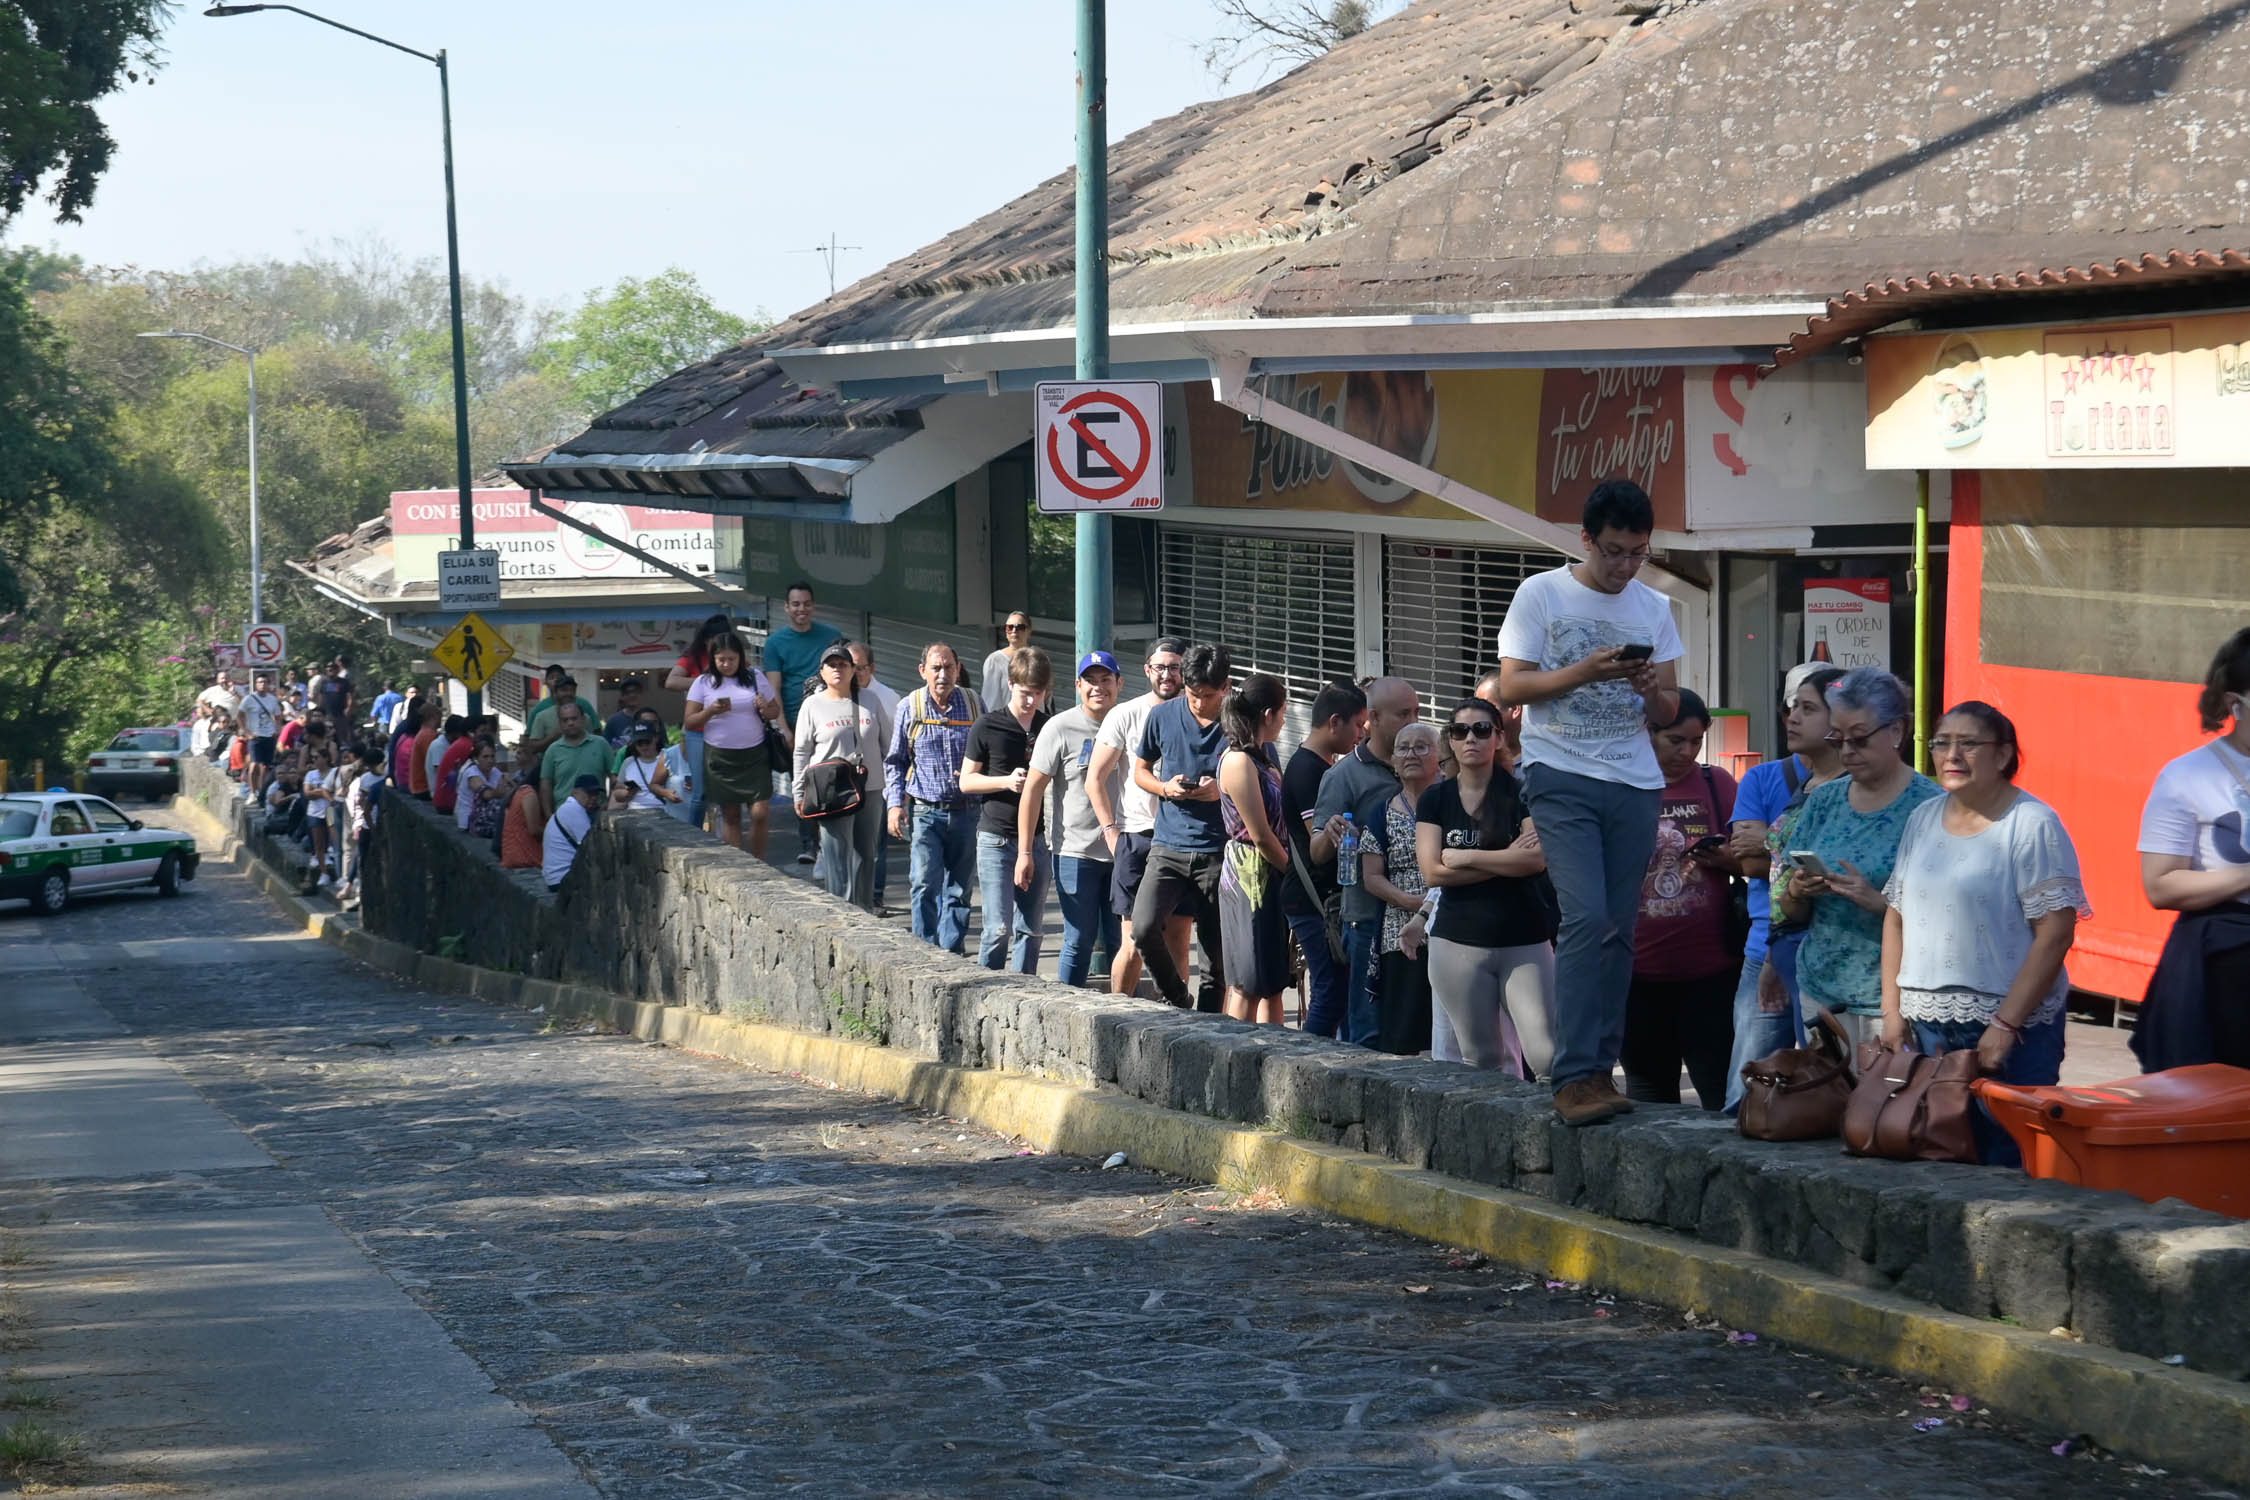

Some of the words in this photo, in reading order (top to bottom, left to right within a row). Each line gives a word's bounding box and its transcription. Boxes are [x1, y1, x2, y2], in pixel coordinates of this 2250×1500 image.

[1130, 497, 1160, 507] ADO
[407, 504, 447, 520] CON
[452, 502, 545, 519] EQUISIT
[448, 537, 555, 557] Dsayunos
[636, 532, 724, 551] Comidas
[443, 558, 475, 569] ELIJA
[480, 557, 494, 567] SU
[499, 561, 556, 576] Tortas
[637, 558, 690, 574] Taos
[447, 575, 492, 586] CARRIL
[1836, 601, 1864, 609] COMBO
[1836, 616, 1882, 634] ORDEN
[1853, 636, 1872, 648] DE
[1840, 652, 1881, 668] TACOS
[826, 718, 872, 729] WEEKND
